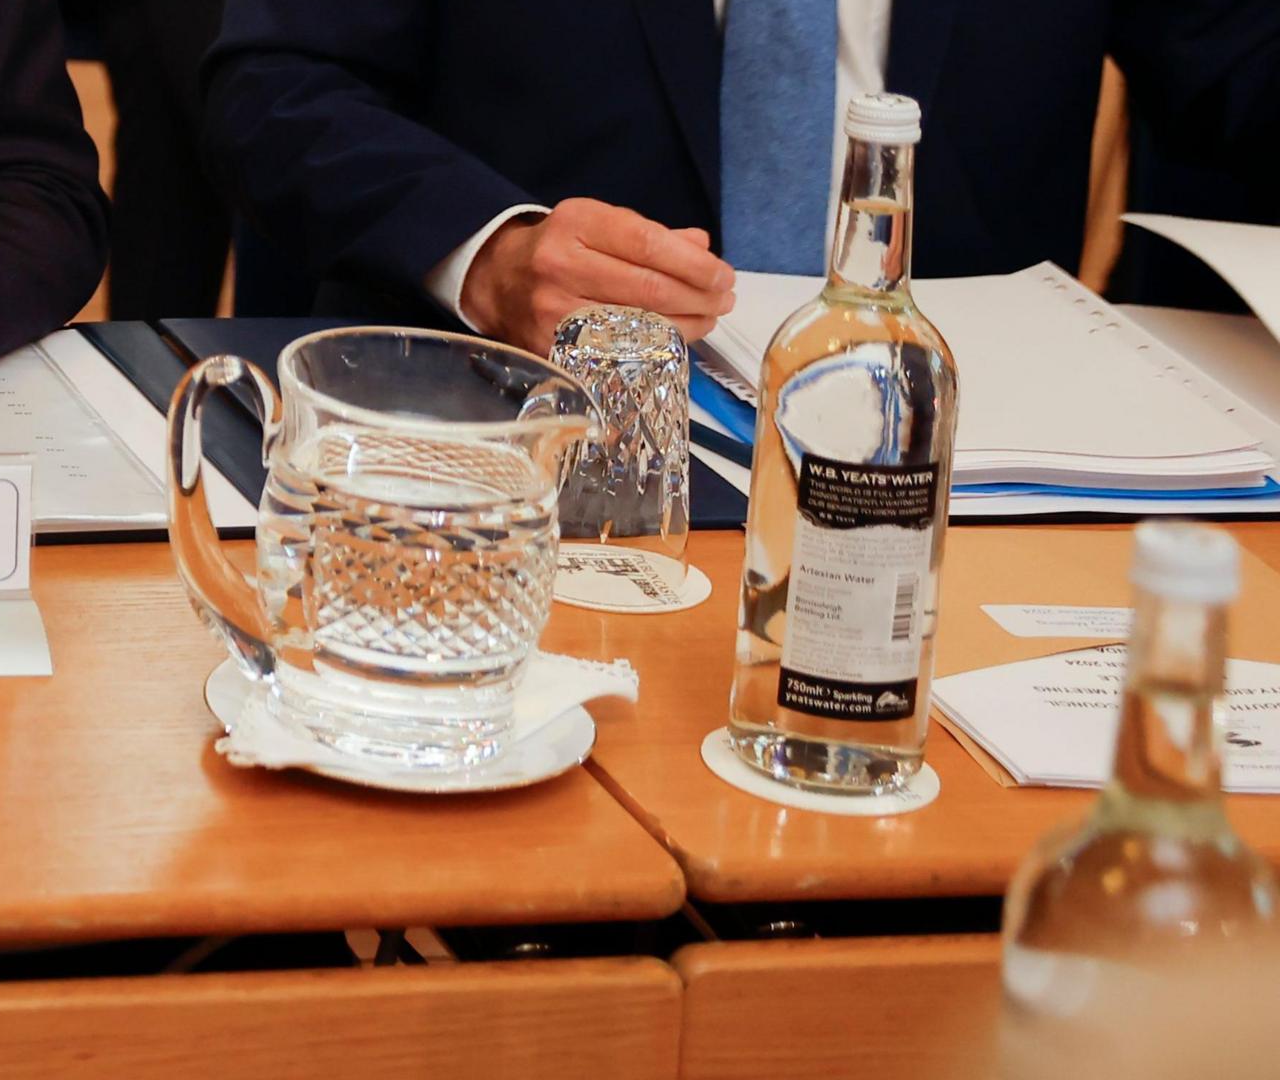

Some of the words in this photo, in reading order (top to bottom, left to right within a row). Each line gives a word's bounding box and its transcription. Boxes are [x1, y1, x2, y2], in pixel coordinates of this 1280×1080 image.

[809, 463, 838, 479] W.B.
[891, 470, 933, 486] WATER
[810, 479, 827, 490] THE
[800, 564, 841, 581] Artesian
[844, 573, 875, 584] Water
[785, 691, 872, 714] yeatswater.com
[833, 689, 873, 703] Sparkling
[1043, 699, 1121, 710] COUNCIL
